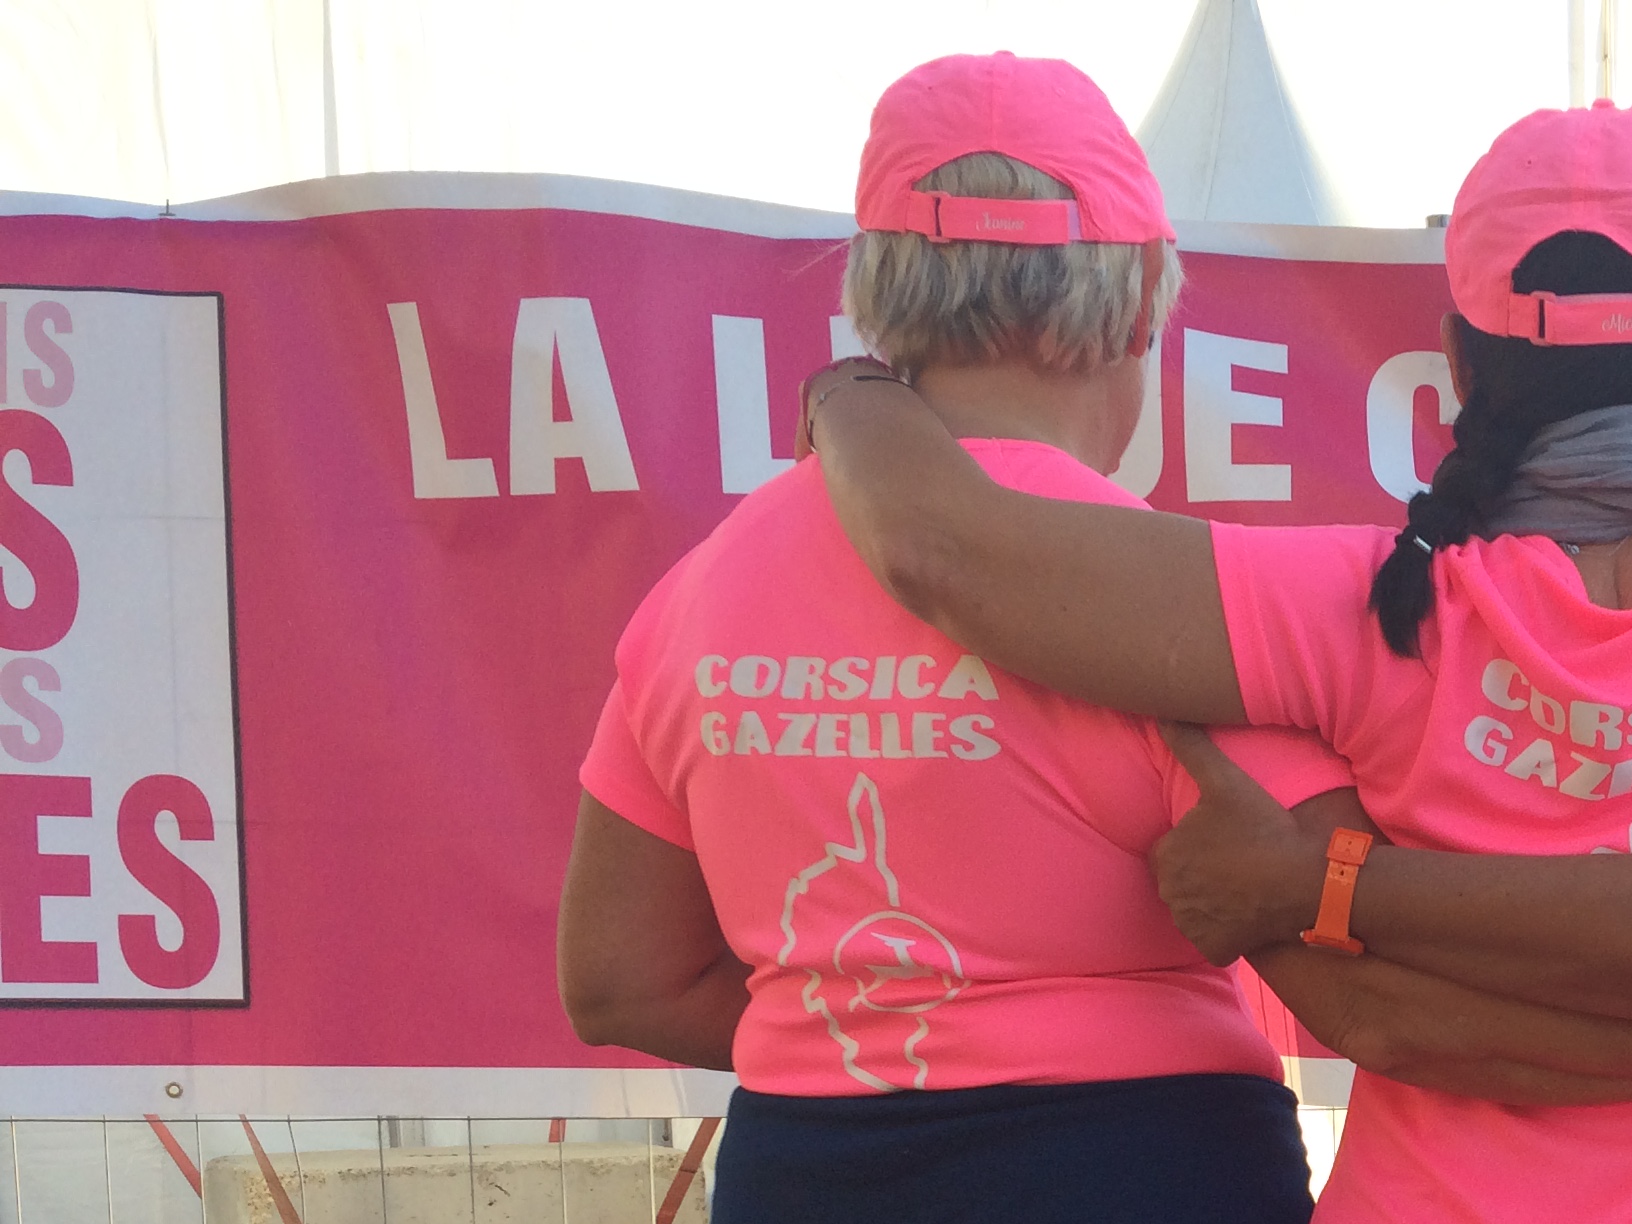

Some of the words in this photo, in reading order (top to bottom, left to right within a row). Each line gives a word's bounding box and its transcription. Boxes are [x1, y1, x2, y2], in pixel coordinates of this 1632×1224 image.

[387, 296, 640, 499] LA
[694, 654, 1000, 701] CORSICA
[700, 711, 1002, 761] GAZELLES
